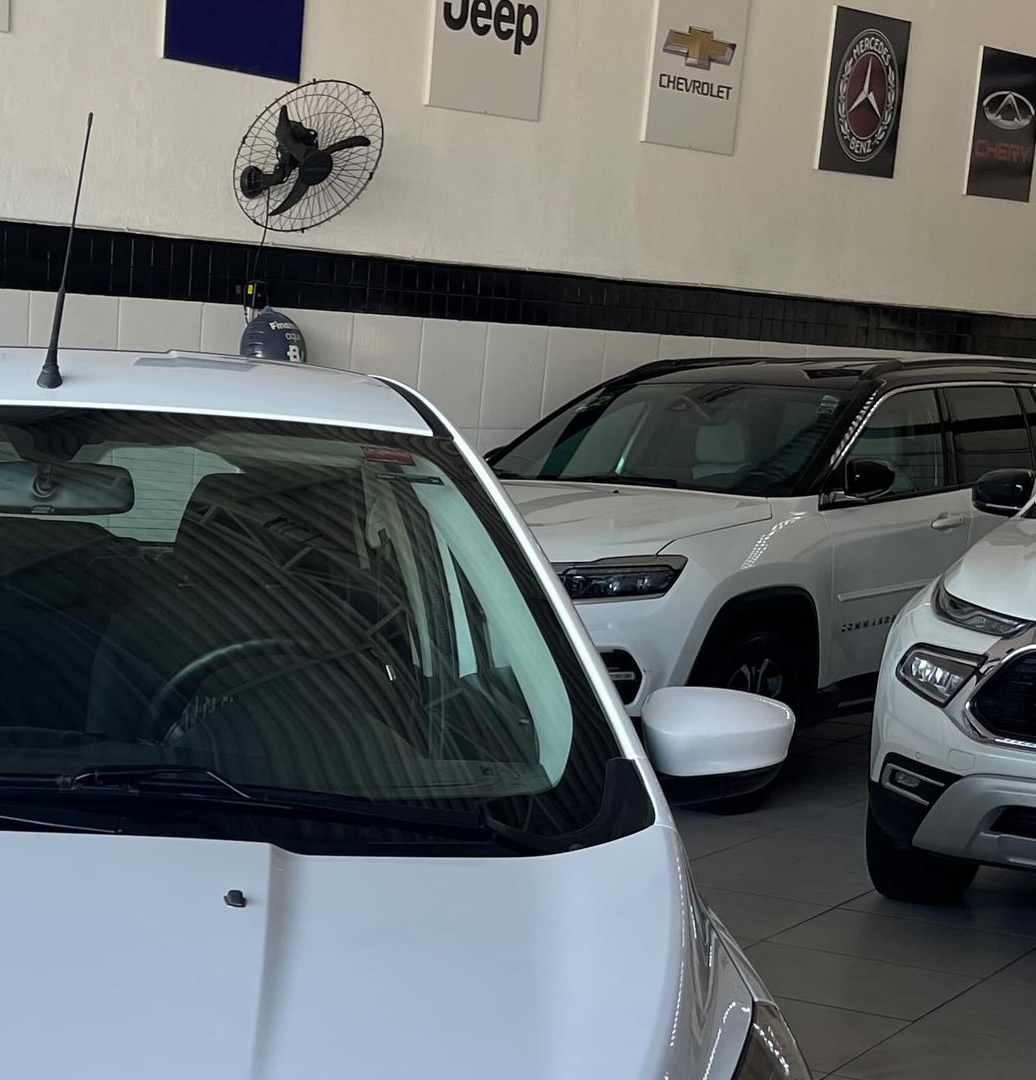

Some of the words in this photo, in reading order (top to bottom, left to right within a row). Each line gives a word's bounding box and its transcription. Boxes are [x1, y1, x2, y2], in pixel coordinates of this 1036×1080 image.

[444, 0, 539, 55] Jeep
[852, 37, 891, 66] MERCEDES
[659, 73, 732, 100] CHEVROLET
[849, 138, 873, 154] BENZ
[975, 140, 1031, 162] CHERY
